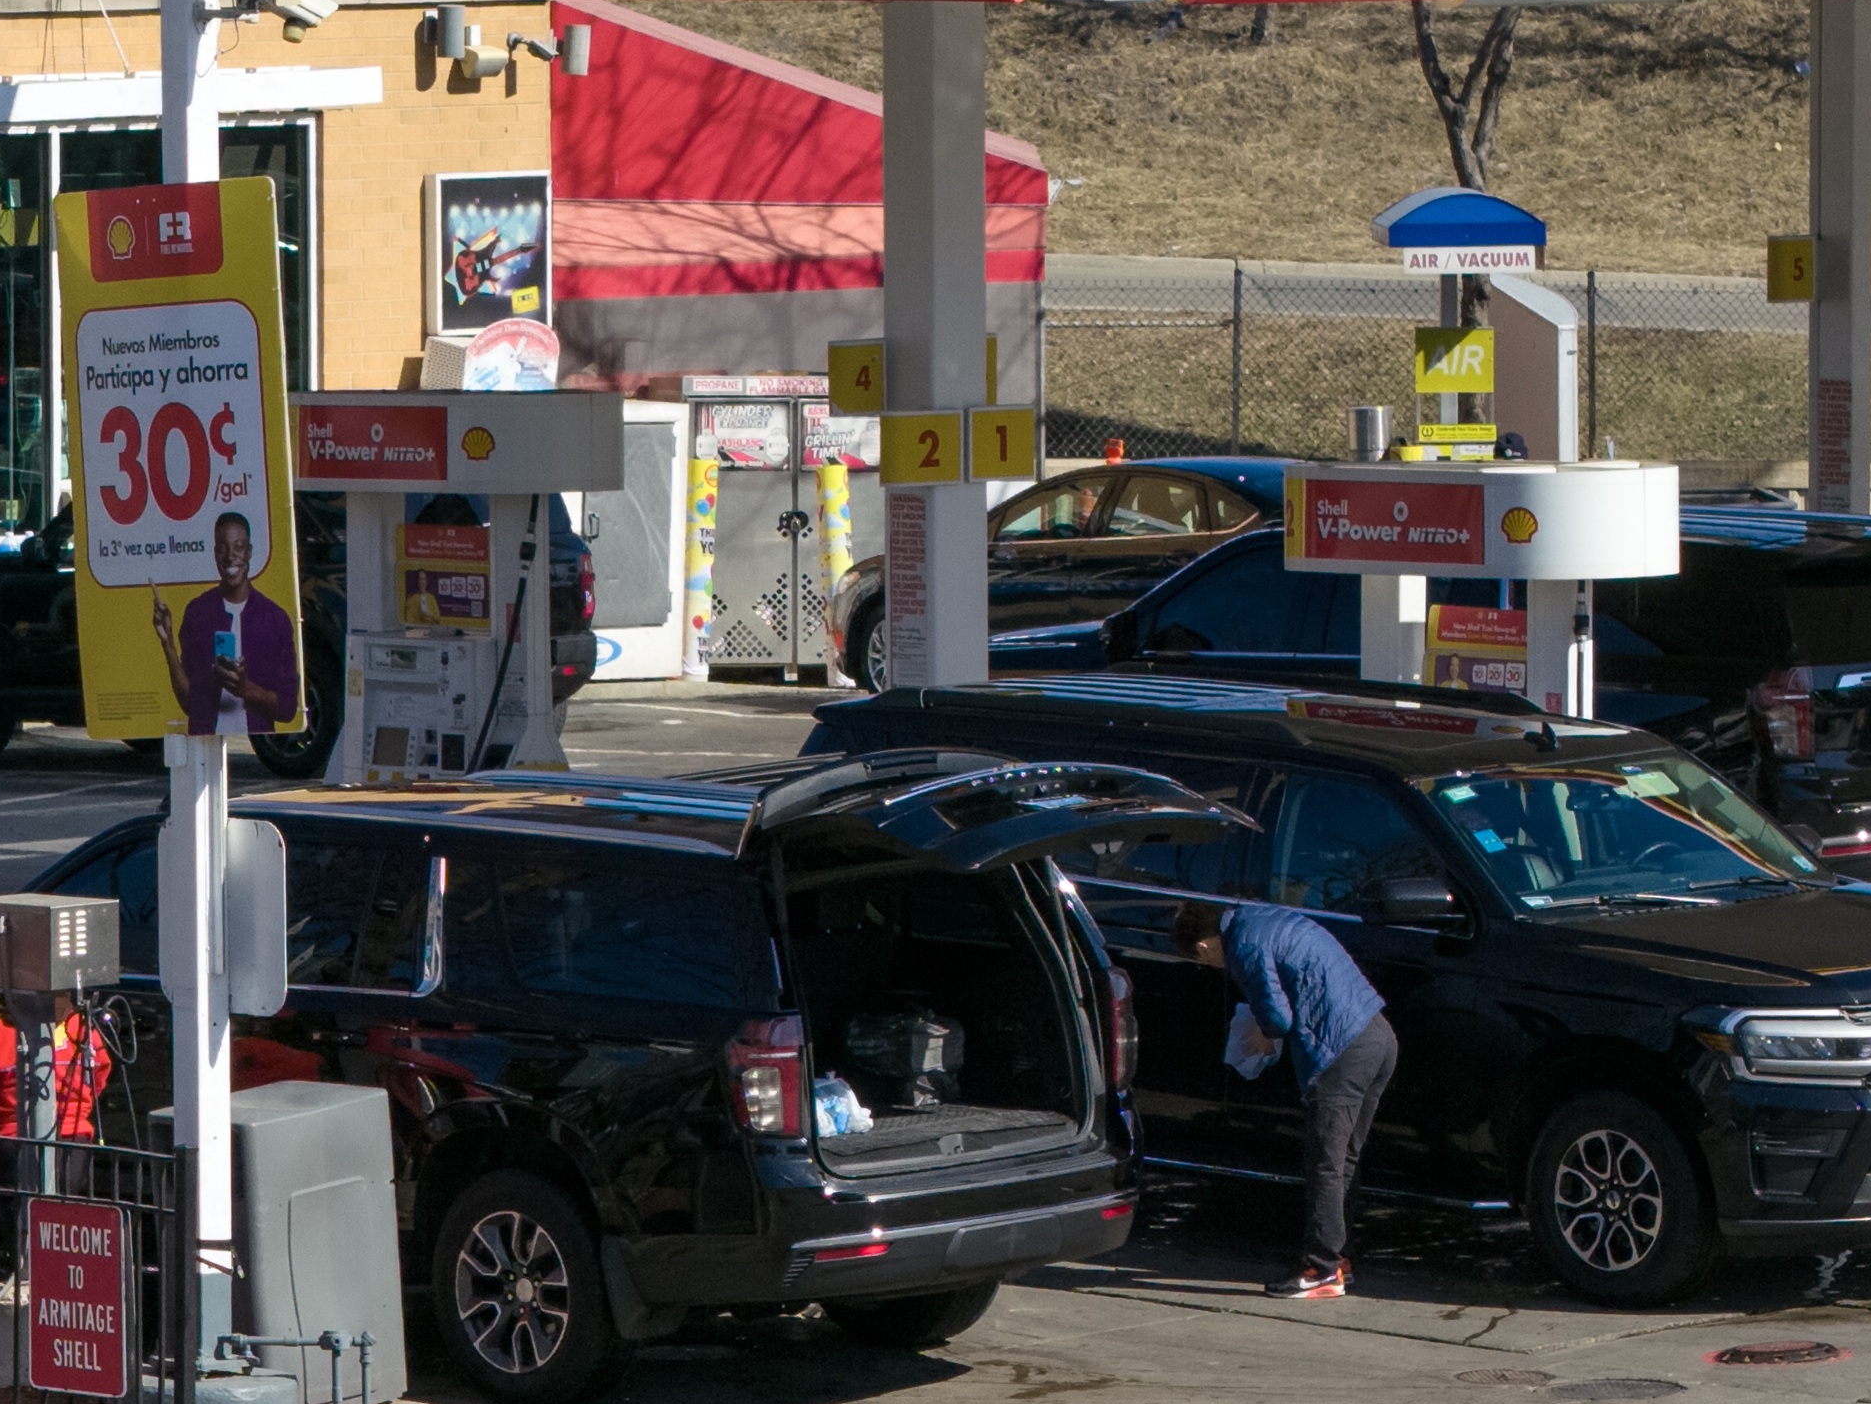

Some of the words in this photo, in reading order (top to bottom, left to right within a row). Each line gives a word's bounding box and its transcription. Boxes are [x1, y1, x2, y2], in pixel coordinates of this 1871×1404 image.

[1409, 253, 1439, 269] AIR
[1457, 253, 1530, 268] VACUUM
[1792, 257, 1804, 281] 5
[102, 335, 144, 356] Nuevos
[148, 332, 220, 353] Miembros
[1427, 343, 1484, 376] AIR
[85, 363, 155, 393] Participa
[159, 368, 173, 392] y
[177, 358, 249, 385] ahorra
[695, 380, 740, 389] PROPANE
[759, 379, 773, 387] NO
[855, 365, 872, 391] 4
[712, 405, 773, 417] CYLINDER
[307, 423, 333, 438] Shell
[308, 440, 378, 461] V-Power
[918, 429, 941, 468] 2
[995, 425, 1008, 462] 1
[1317, 500, 1348, 517] Shell
[1317, 517, 1402, 542] V-Power
[99, 539, 109, 557] la
[124, 543, 142, 556] vez
[145, 543, 166, 559] que
[169, 535, 205, 554] llenas
[39, 1222, 113, 1258] WELCOME
[67, 1264, 84, 1291] TO
[38, 1298, 115, 1335] ARMITAGE
[53, 1338, 101, 1372] SHELL
